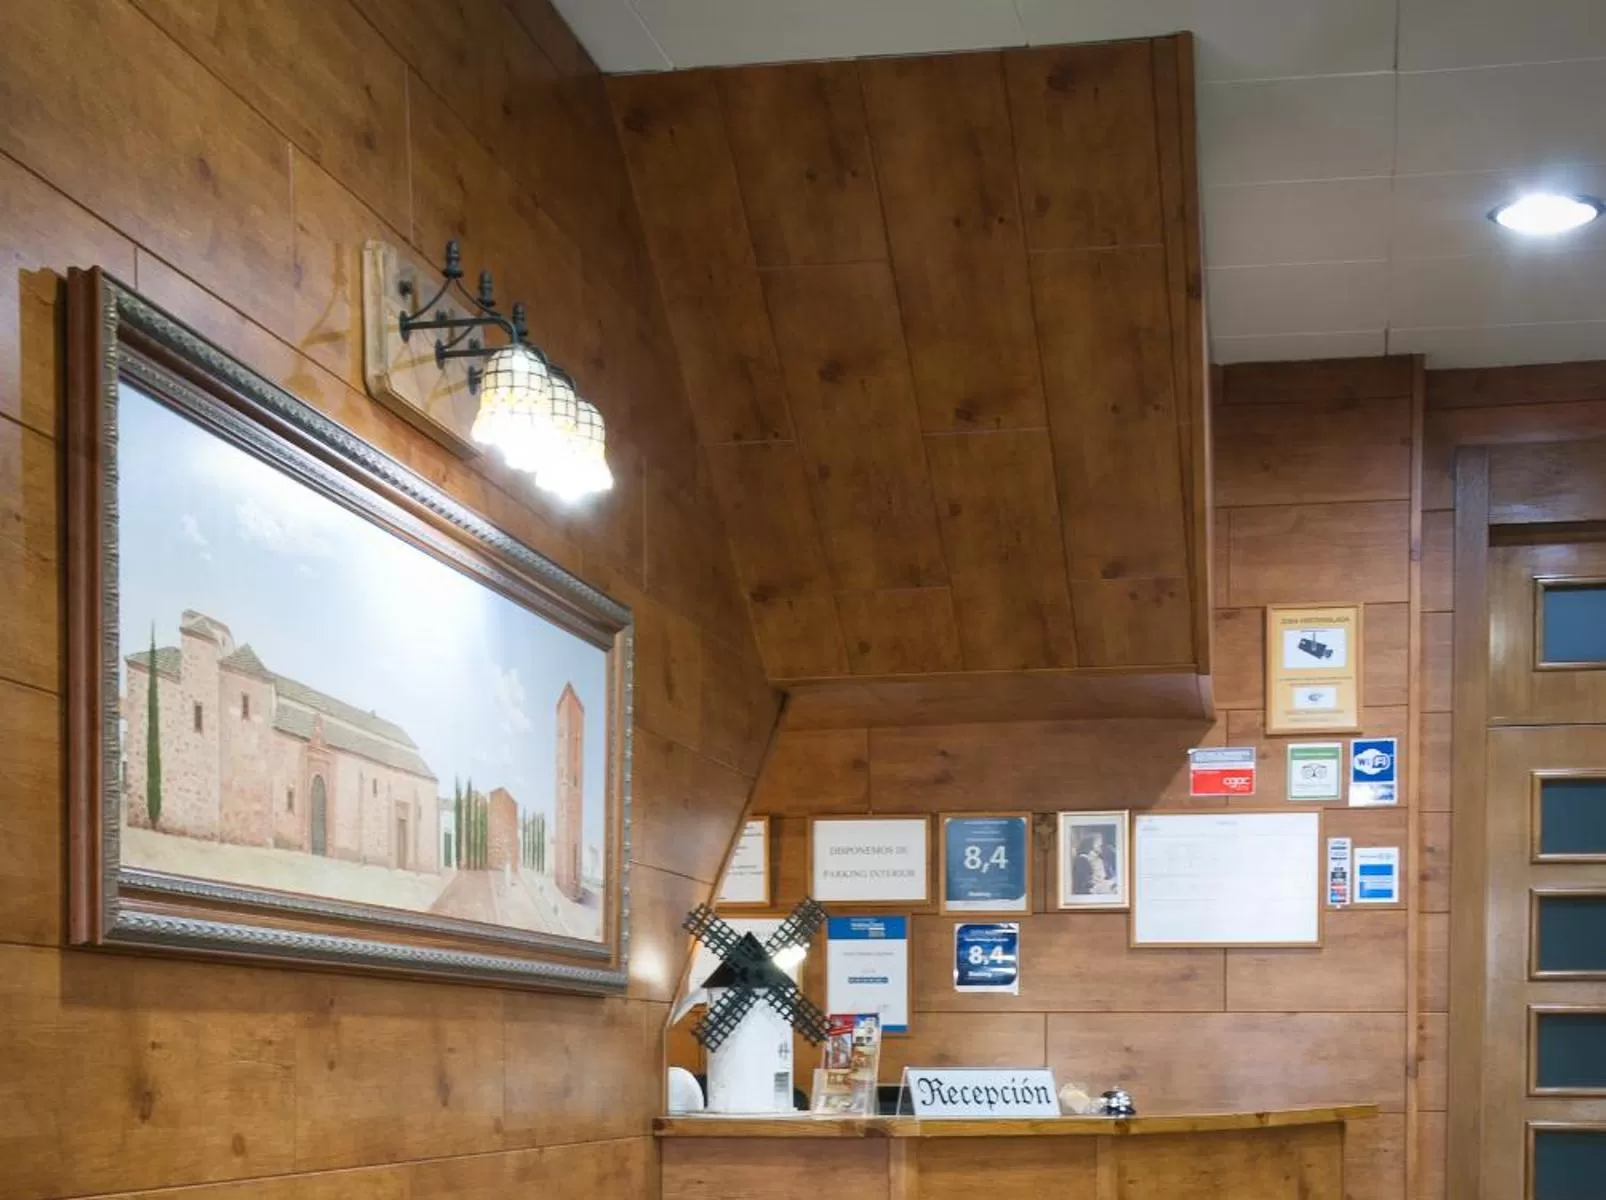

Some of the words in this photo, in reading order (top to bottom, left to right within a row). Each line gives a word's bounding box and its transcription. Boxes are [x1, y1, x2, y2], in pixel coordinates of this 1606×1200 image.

[963, 845, 1009, 874] 8,4
[968, 945, 1004, 966] 8,4
[917, 1076, 1052, 1111] Recepción
